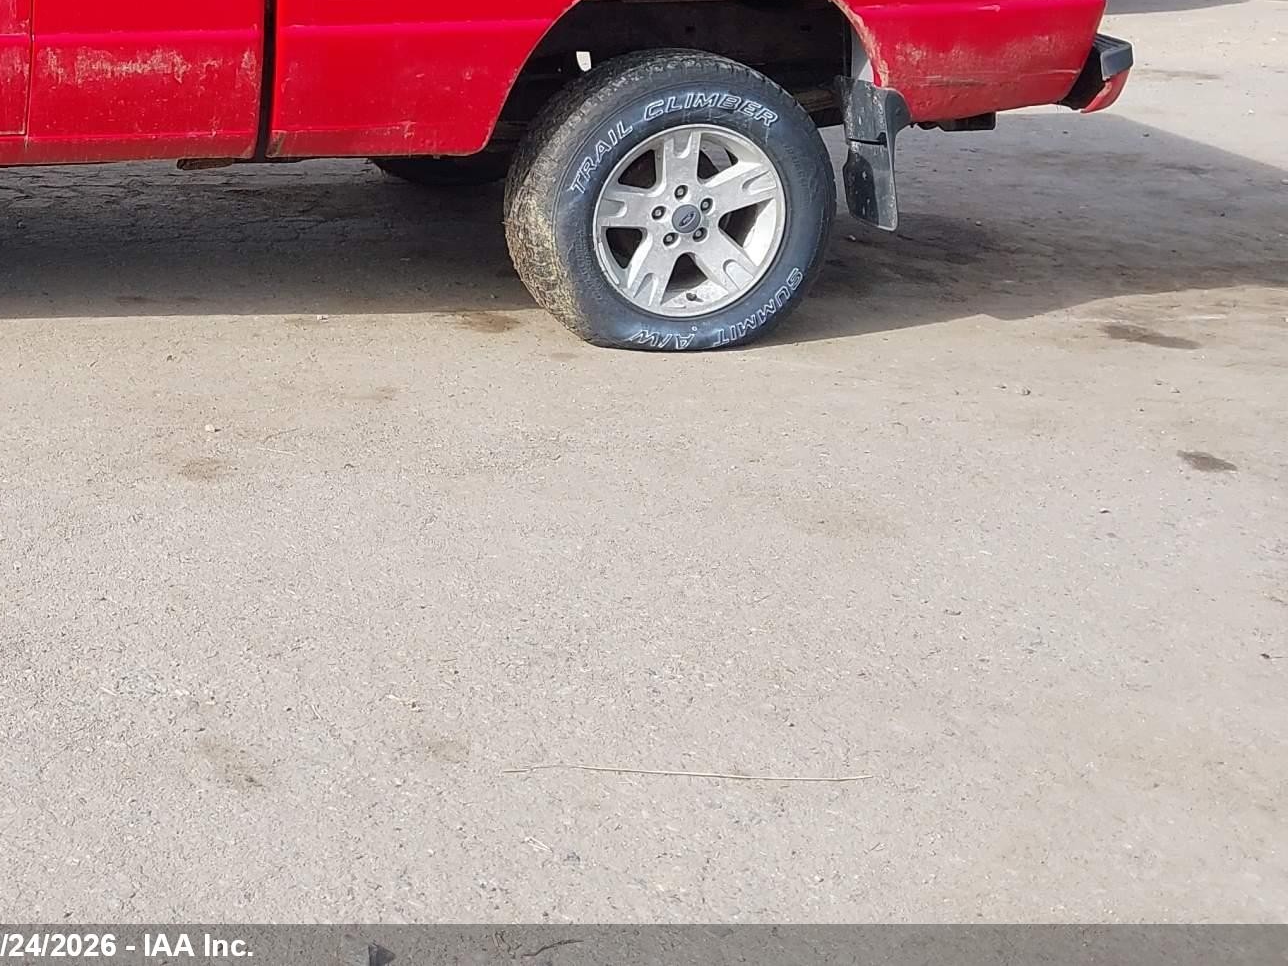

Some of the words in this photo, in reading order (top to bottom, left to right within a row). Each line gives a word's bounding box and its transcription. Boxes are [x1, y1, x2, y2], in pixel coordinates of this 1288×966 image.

[566, 119, 634, 195] TRAIL
[643, 92, 779, 128] CLIMBER
[712, 266, 804, 347] SUMMIT
